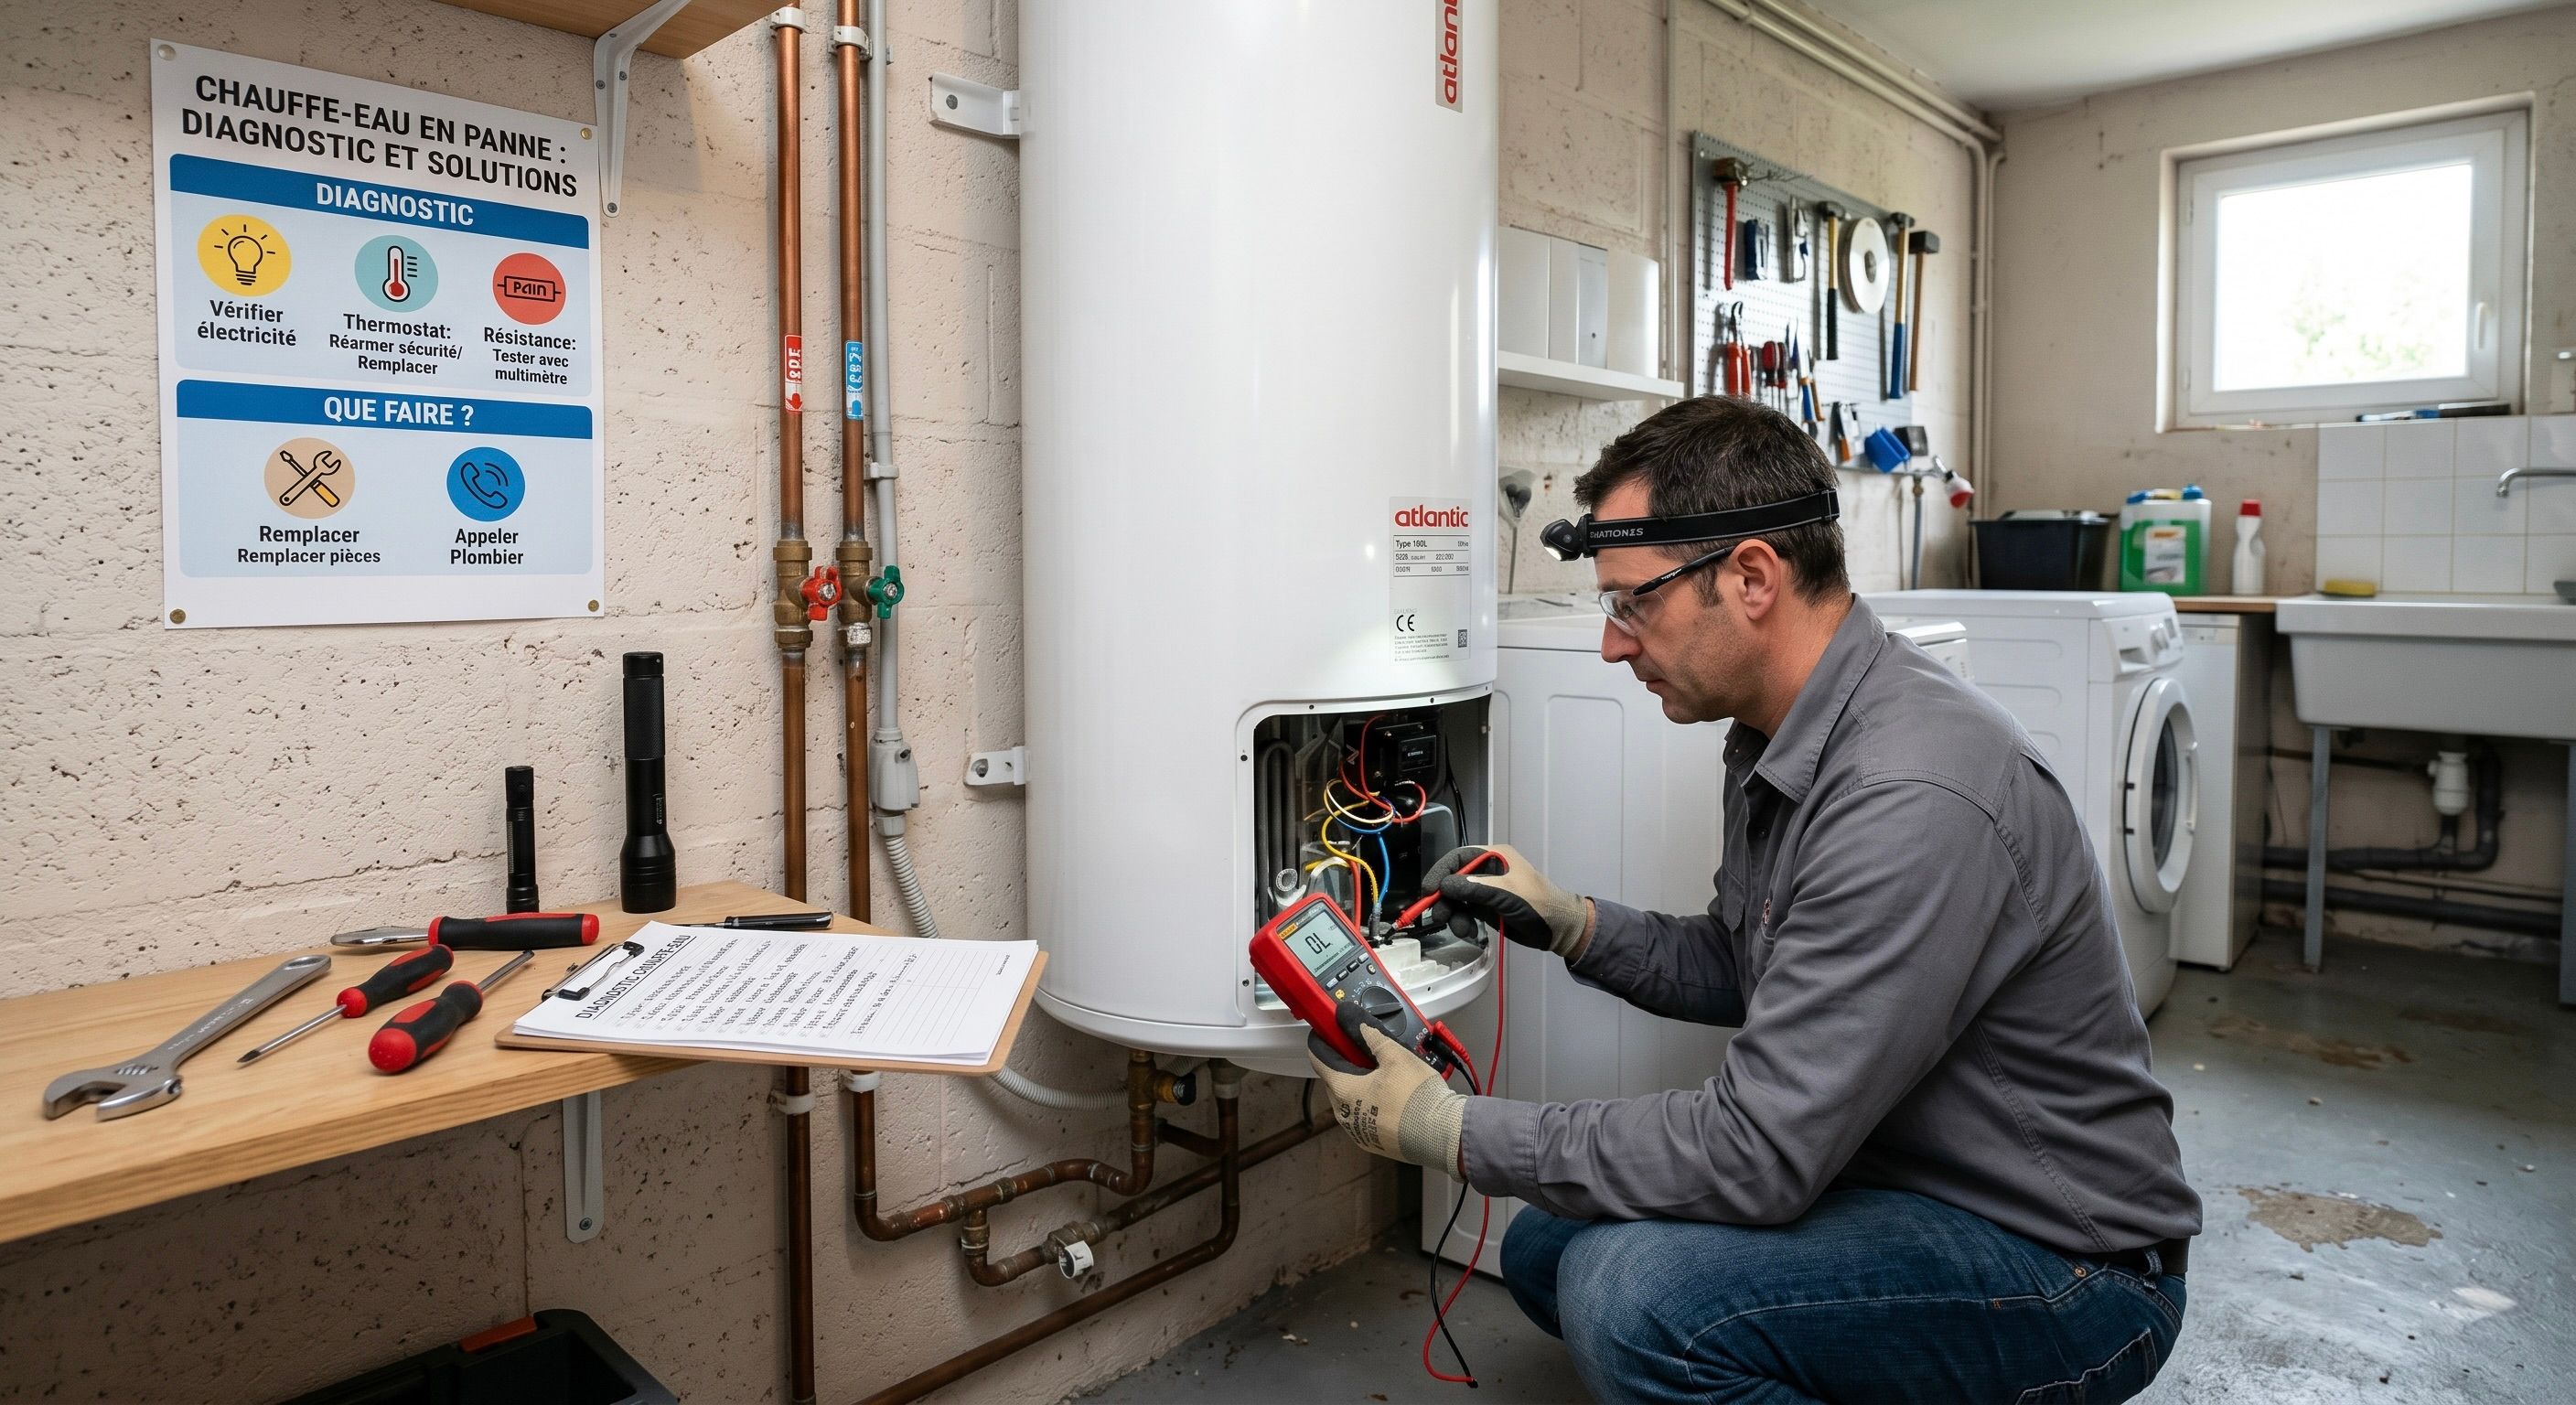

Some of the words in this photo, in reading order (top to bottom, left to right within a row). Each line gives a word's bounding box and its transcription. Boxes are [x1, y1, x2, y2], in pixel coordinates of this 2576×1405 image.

[195, 75, 410, 135] CHAUFFE-EAU
[420, 114, 455, 145] EN
[465, 123, 552, 161] PANNE
[182, 108, 376, 164] DIAGNOSTIC
[385, 143, 419, 171] ET
[427, 151, 577, 198] SOLUTIONS
[317, 182, 474, 226] DIAGNOSTIC
[209, 299, 284, 323] Vérifier
[197, 321, 296, 347] électricité
[343, 313, 451, 339] Thermostat:
[329, 334, 394, 353] Réarmer
[399, 340, 463, 359] sécurité/
[484, 327, 576, 350] Résistance:
[358, 355, 438, 375] Remplacer
[492, 349, 535, 365] Tester
[539, 355, 569, 368] avec
[495, 368, 568, 385] multimètre
[324, 396, 377, 423] QUE
[384, 400, 454, 425] FAIRE
[460, 404, 475, 426] ?
[1394, 504, 1469, 528] atlantic
[259, 525, 360, 547] Remplacer
[455, 528, 519, 548] Appeler
[1395, 540, 1411, 549] Type
[237, 548, 326, 566] Remplacer
[330, 548, 381, 566] pièces
[450, 548, 524, 564] Plombier
[1396, 614, 1415, 632] CE
